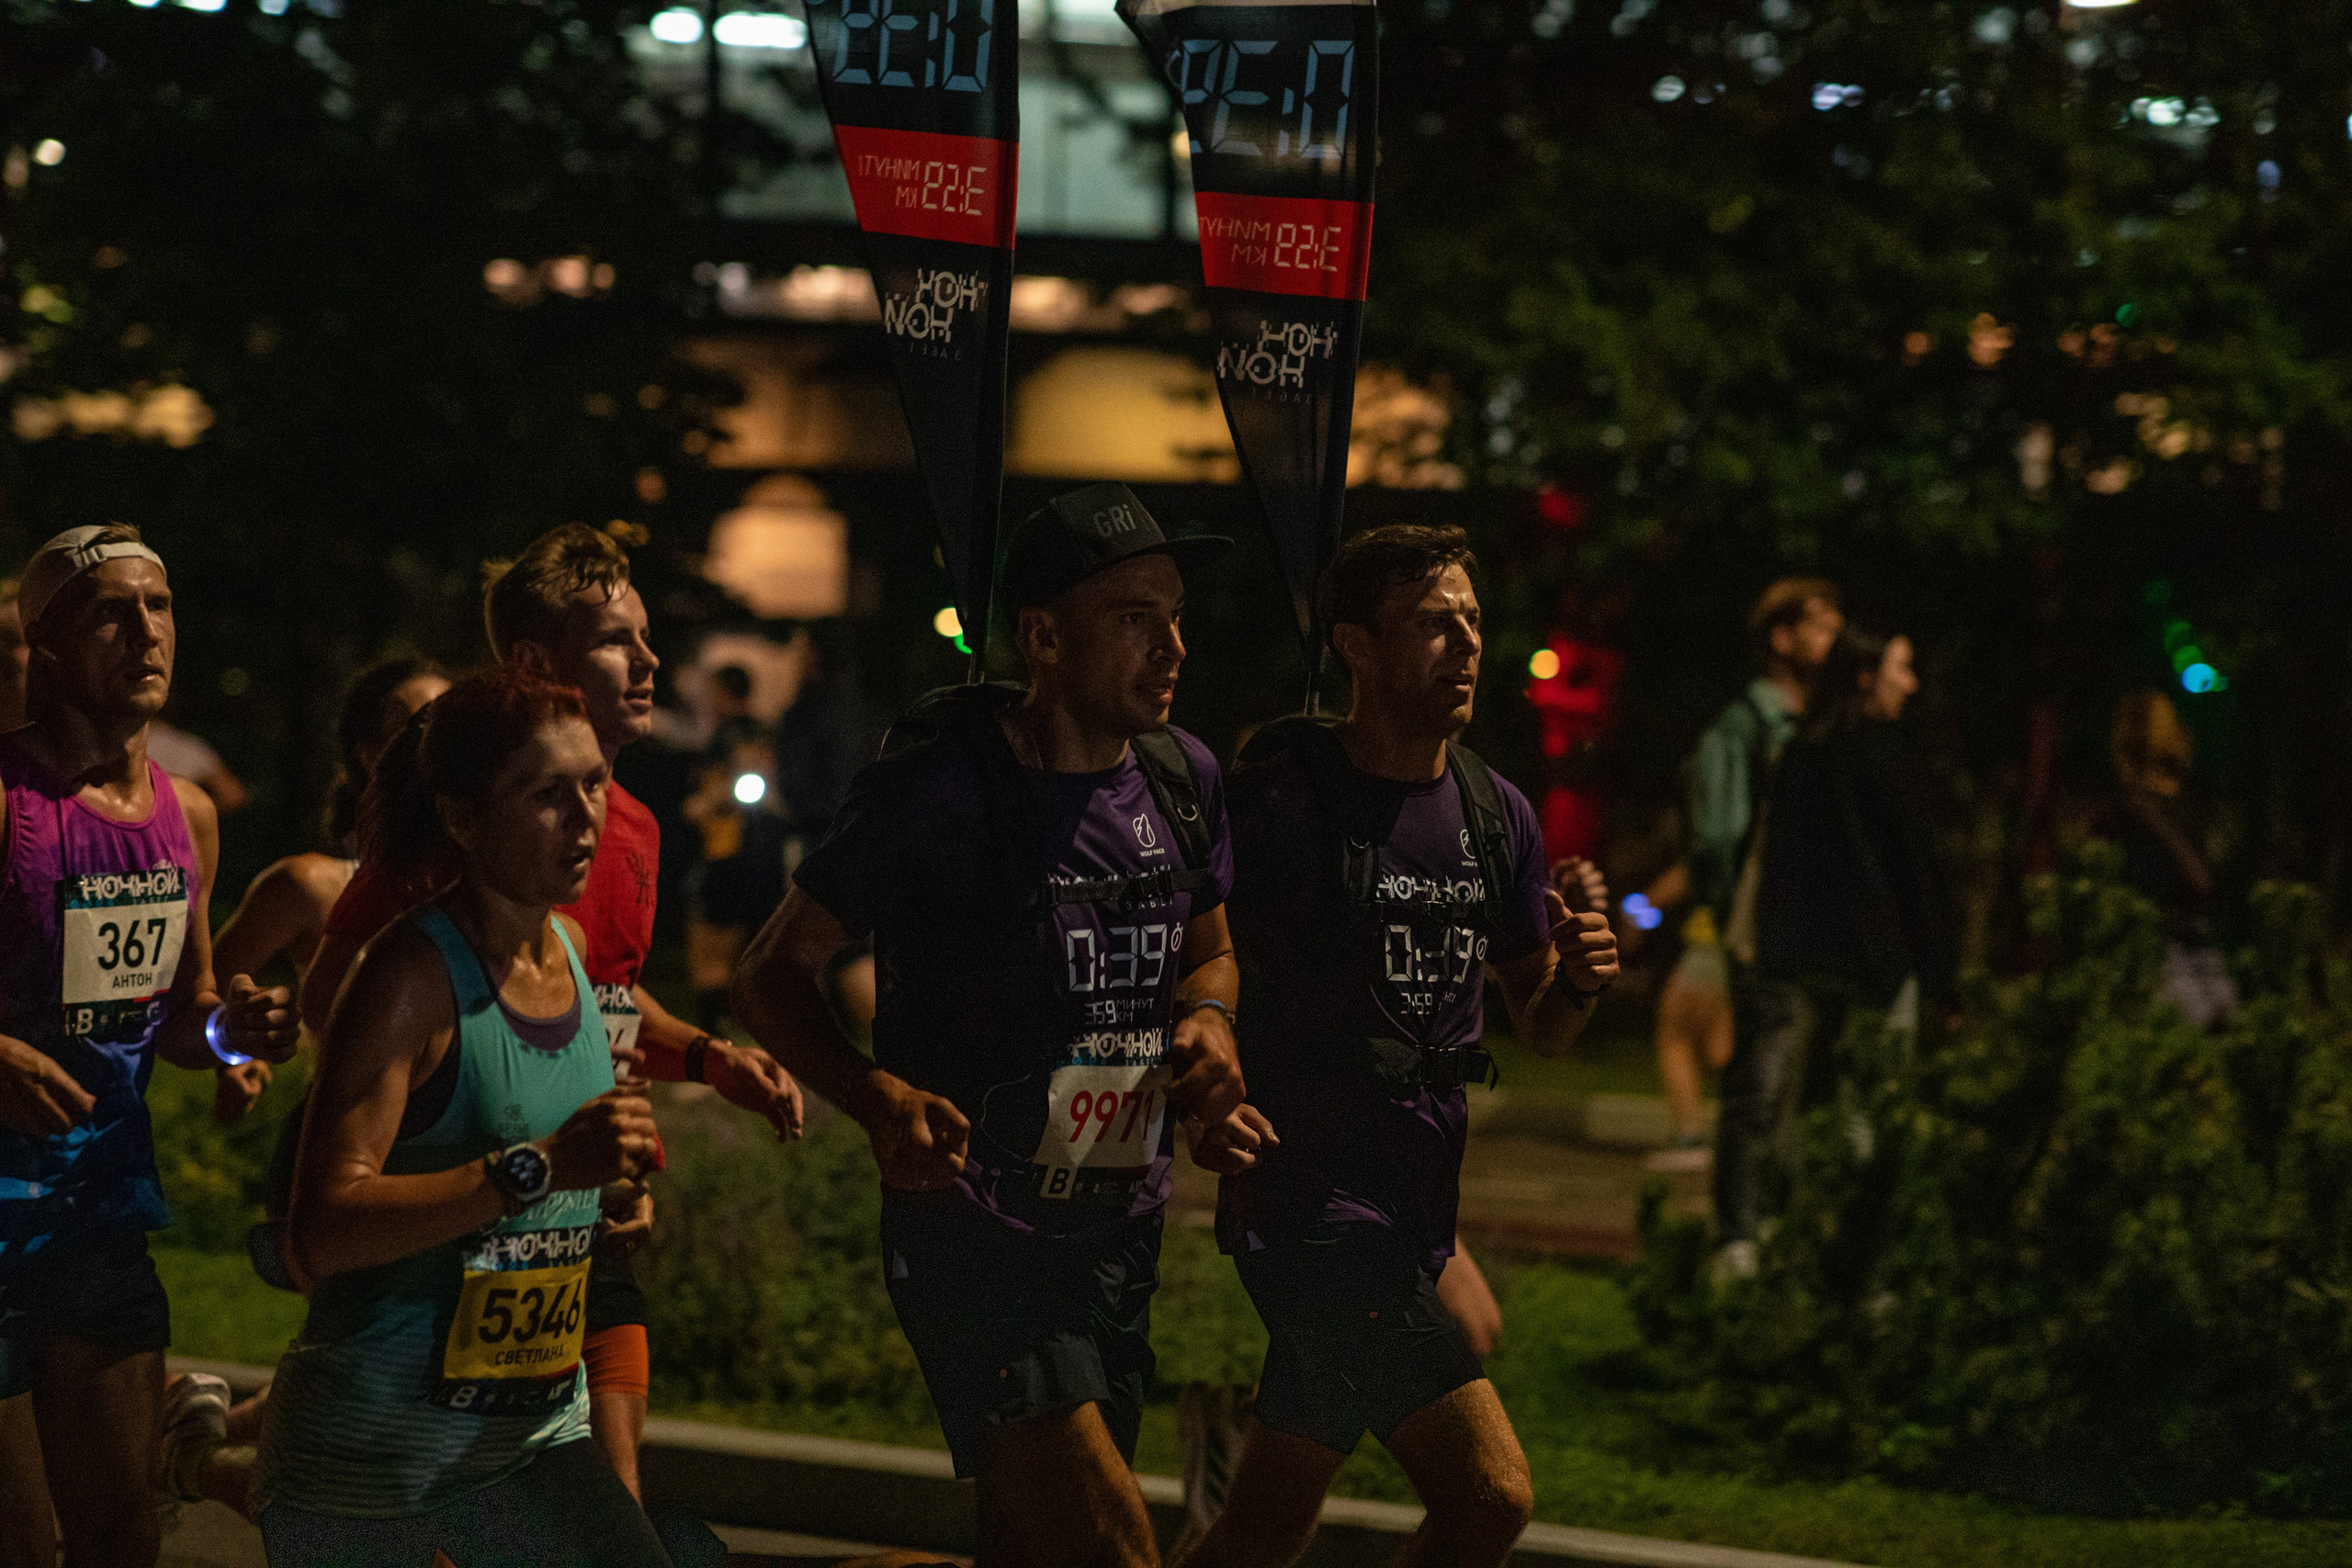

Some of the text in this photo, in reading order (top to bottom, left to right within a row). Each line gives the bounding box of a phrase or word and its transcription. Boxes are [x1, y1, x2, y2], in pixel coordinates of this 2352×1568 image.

[97, 919, 166, 970] 367
[1066, 923, 1168, 993] 0:39
[112, 973, 153, 989] АНТОН
[1069, 1089, 1156, 1143] 9971
[478, 1278, 582, 1344] 5346
[494, 1343, 565, 1367] СВЕТЛАНА
